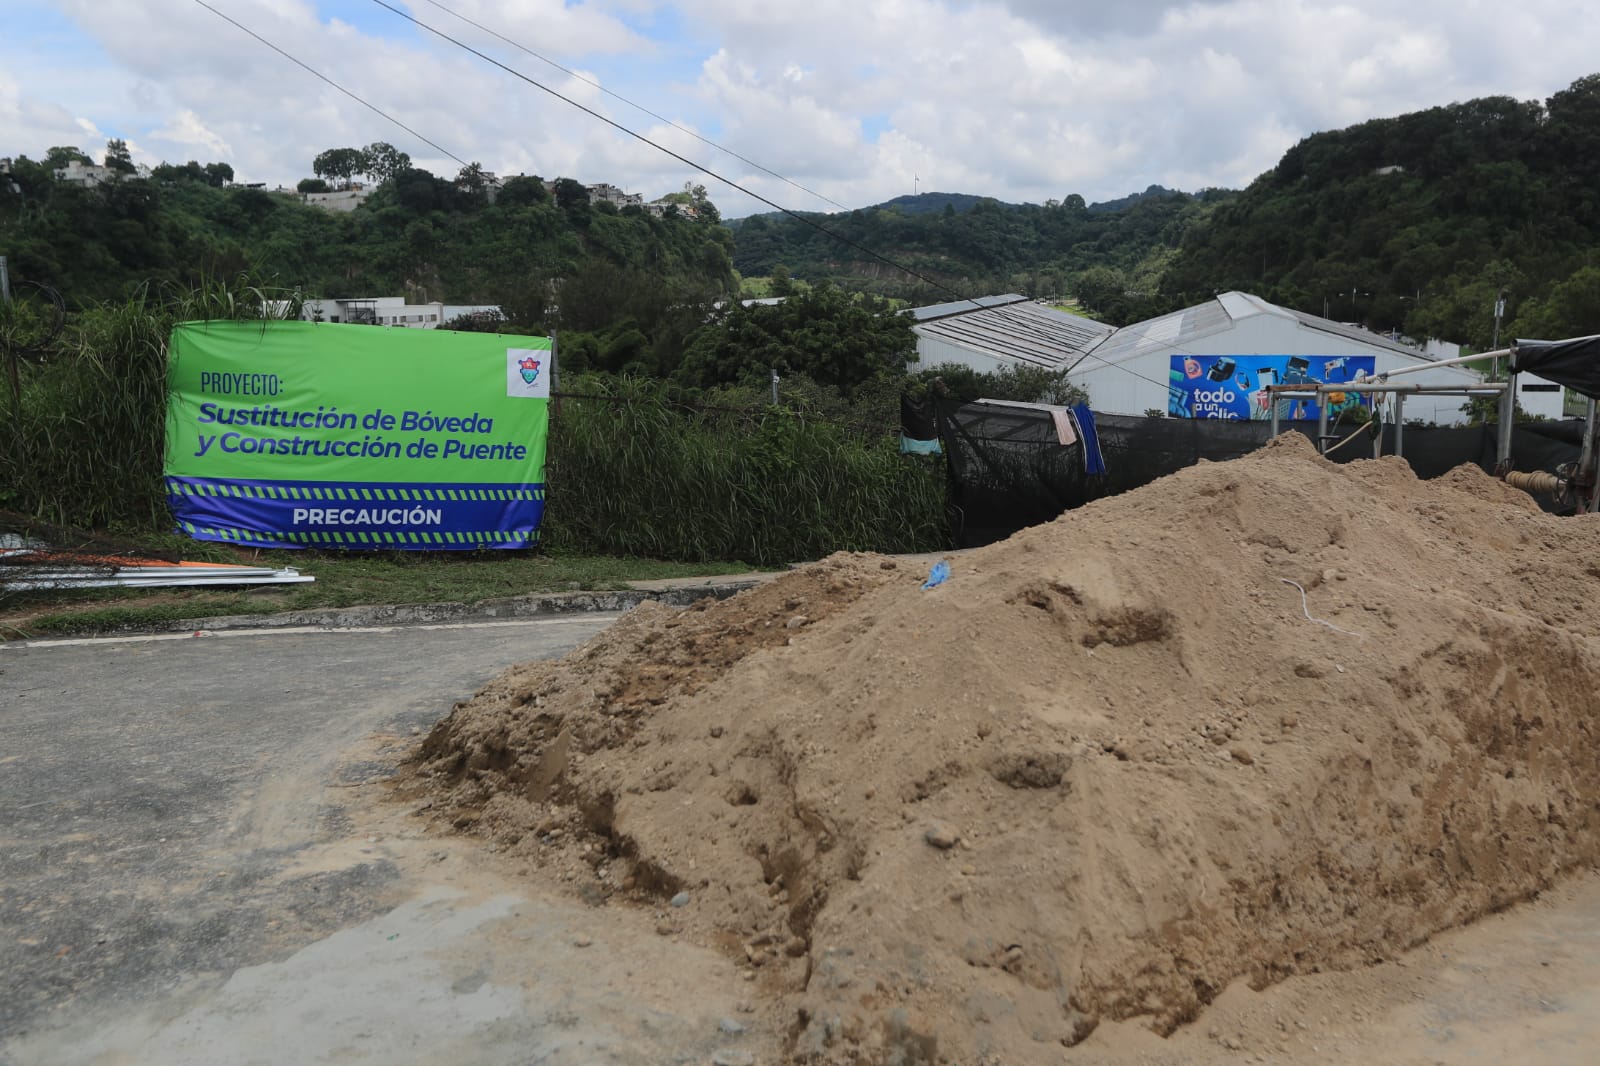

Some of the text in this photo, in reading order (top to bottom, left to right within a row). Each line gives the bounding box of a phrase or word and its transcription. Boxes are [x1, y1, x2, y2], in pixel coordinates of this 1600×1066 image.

[201, 372, 284, 396] PROYECTO:
[1194, 386, 1235, 403] todo
[198, 403, 493, 433] Sustitución de Bóveda
[1195, 403, 1218, 411] a un
[195, 432, 527, 460] y Construcción de Puente
[293, 505, 441, 525] PRECAUCIÓN
